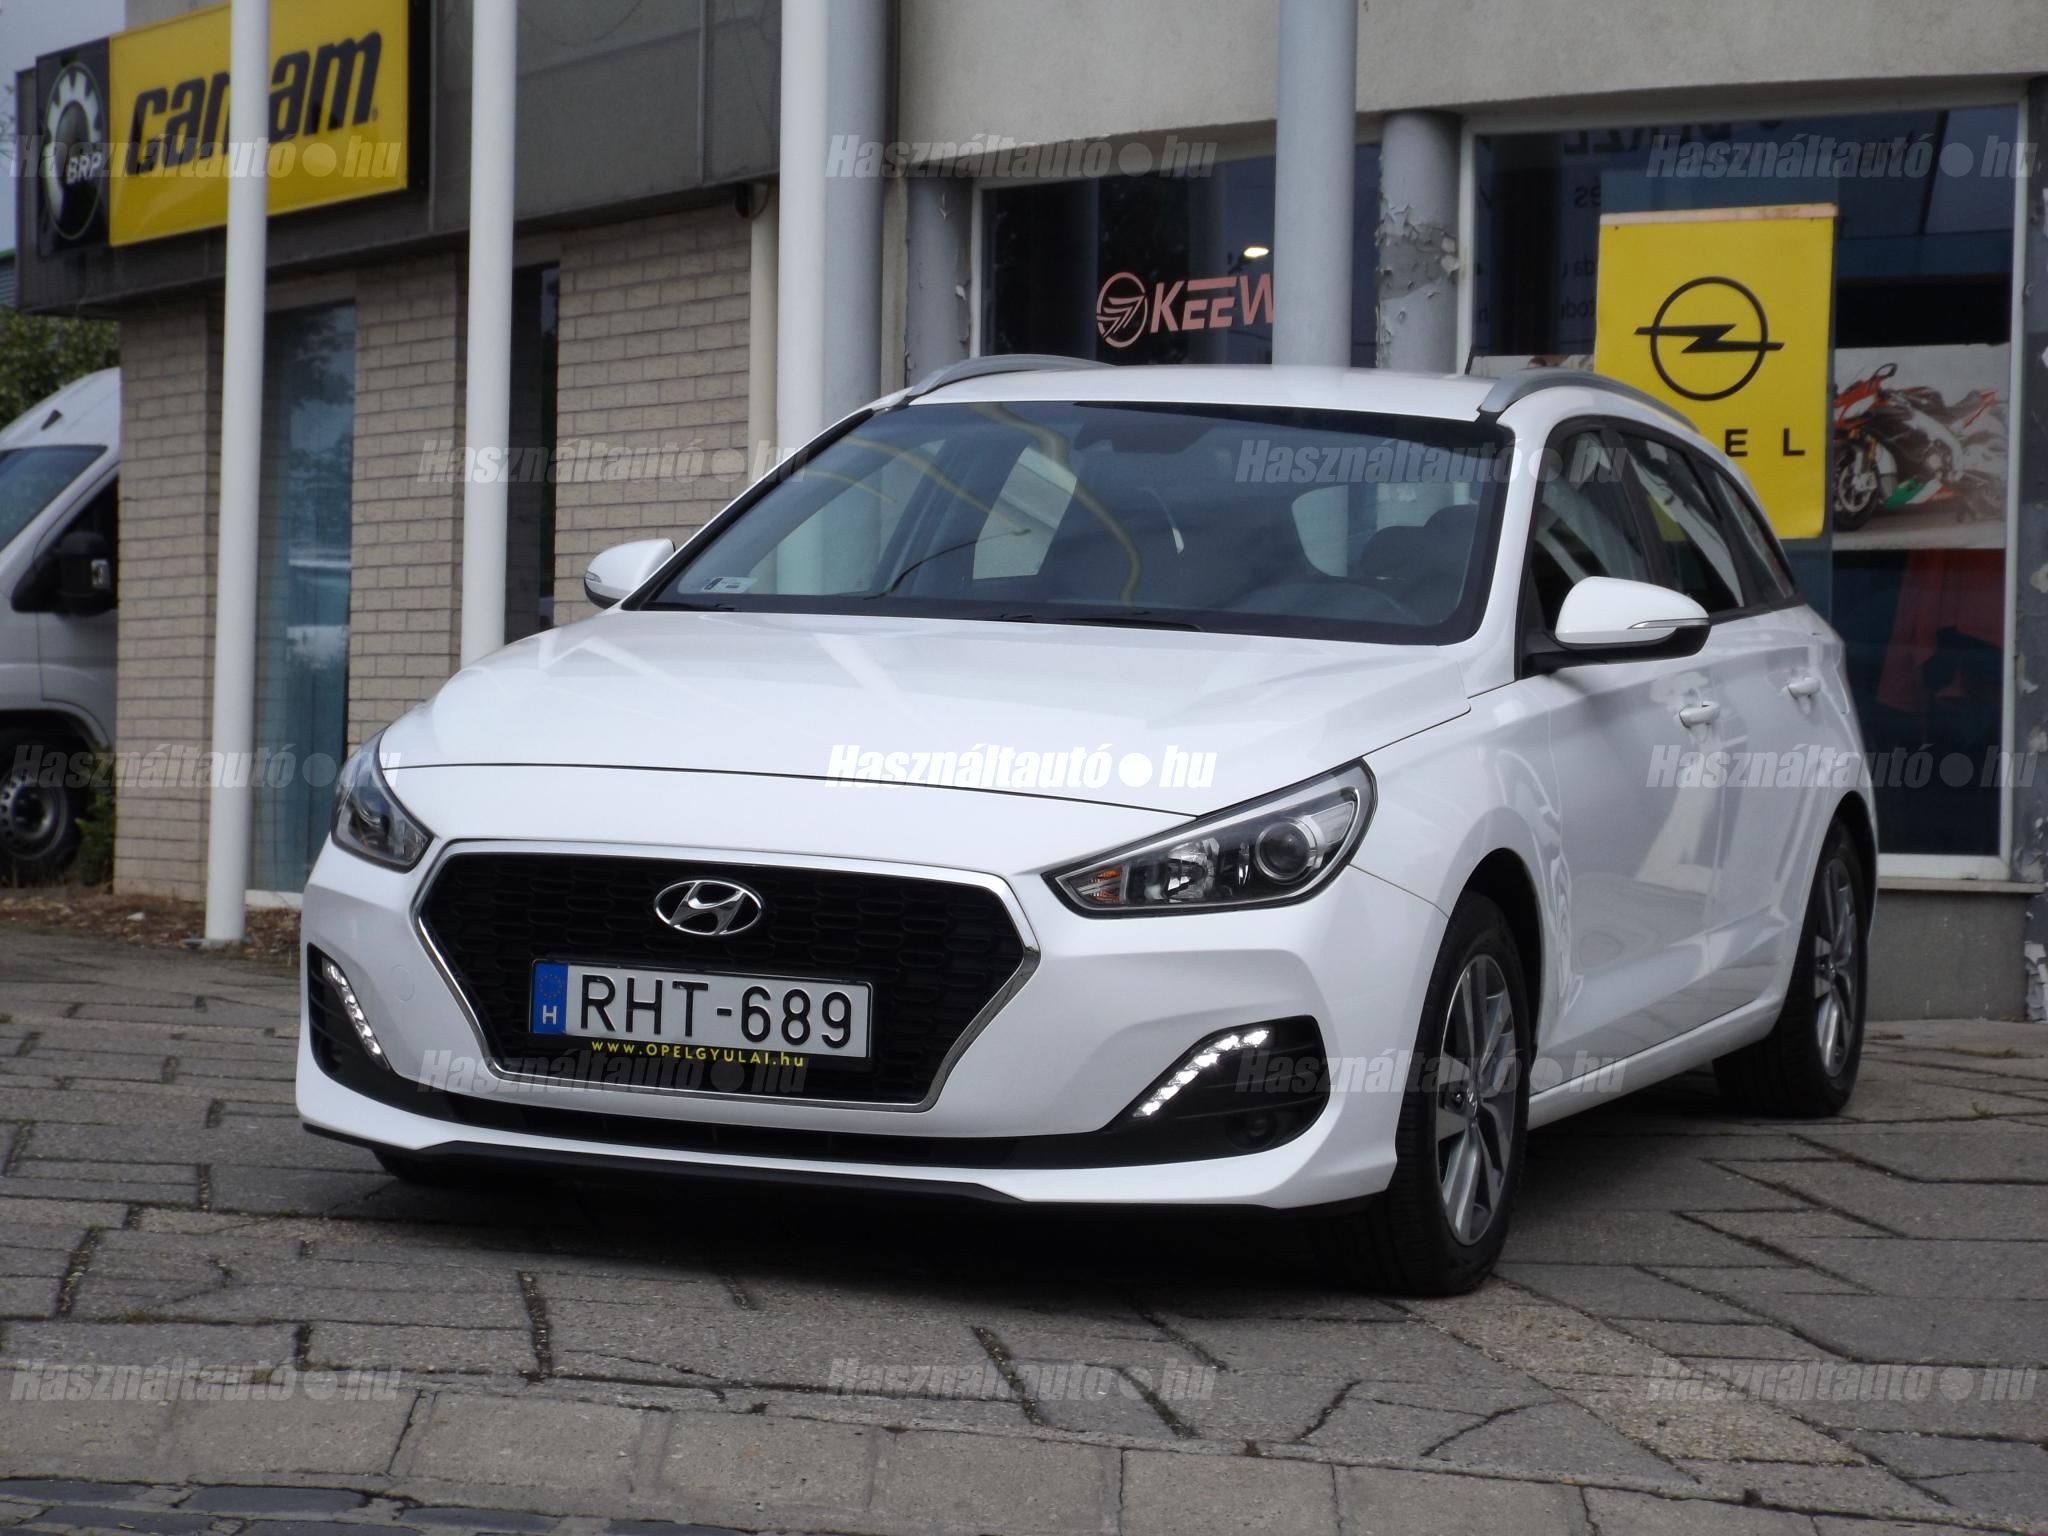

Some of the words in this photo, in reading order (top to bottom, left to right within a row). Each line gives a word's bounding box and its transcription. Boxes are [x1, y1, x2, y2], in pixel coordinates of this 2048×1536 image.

[124, 31, 382, 176] canam
[65, 151, 102, 184] BRP
[1150, 273, 1273, 333] KEEW
[1724, 427, 1805, 457] EL
[542, 1004, 557, 1025] H
[579, 974, 851, 1049] RHT-689
[591, 1040, 805, 1067] www.OPELGYULAI.hu
